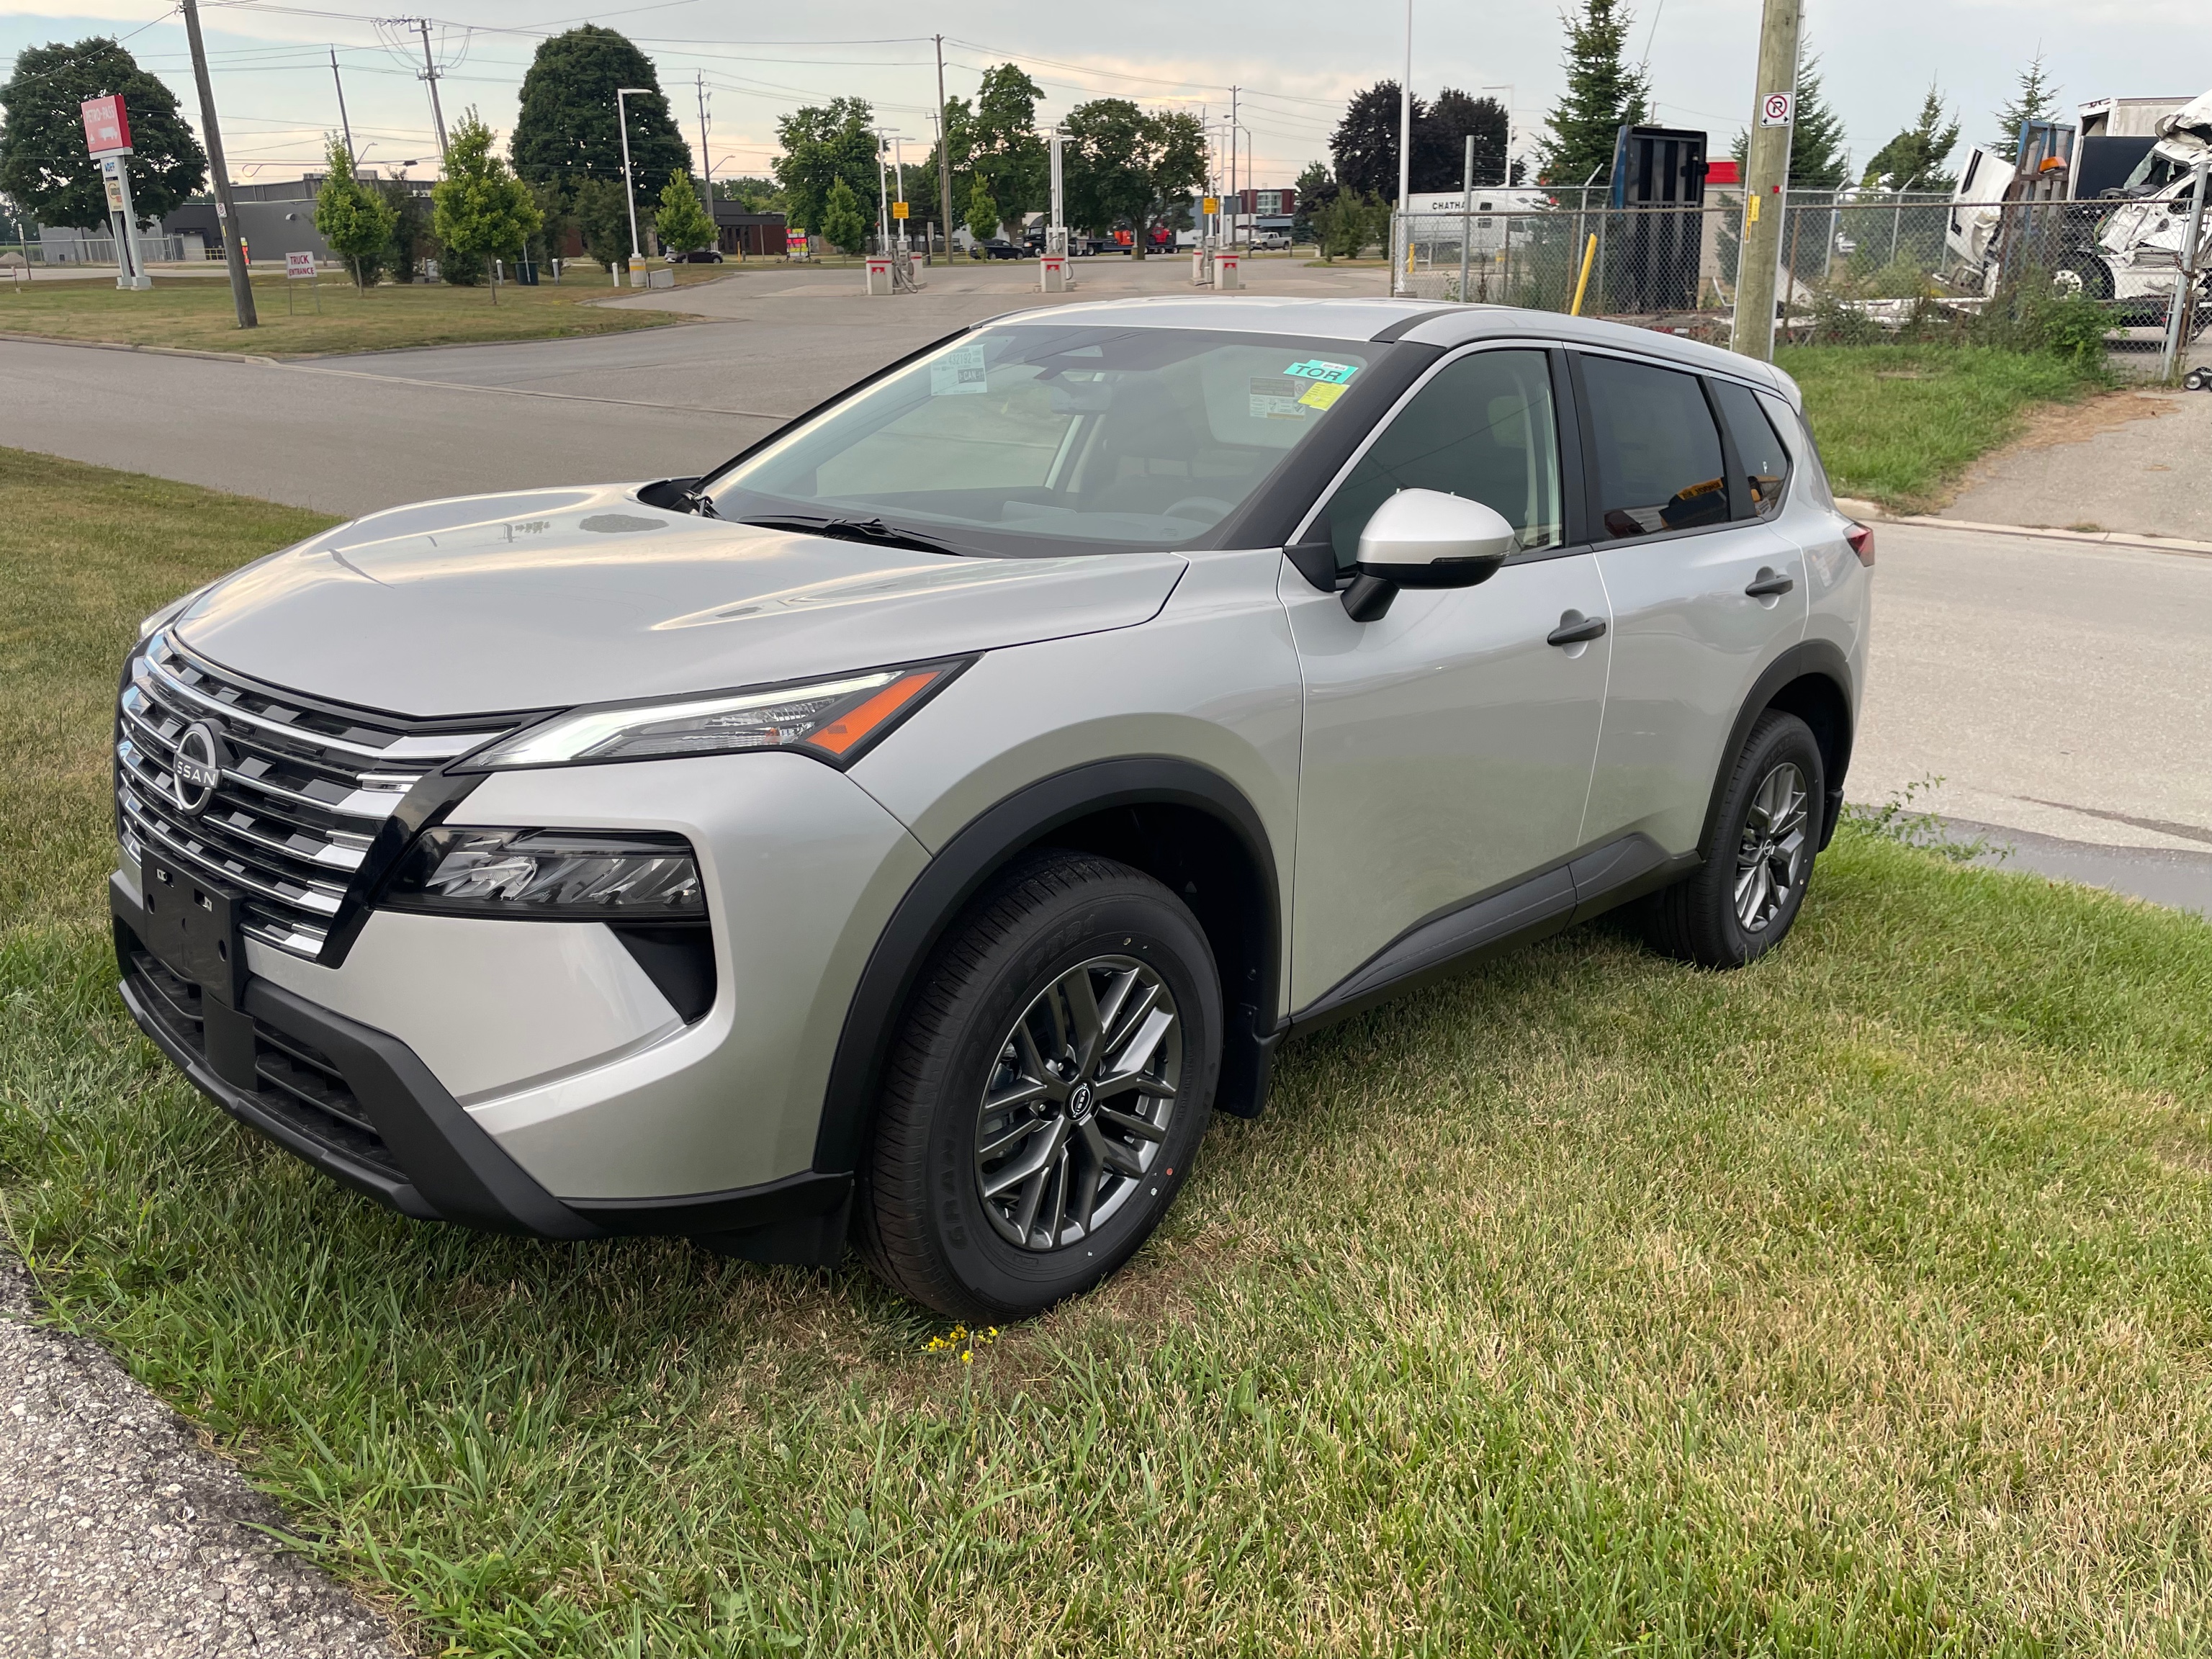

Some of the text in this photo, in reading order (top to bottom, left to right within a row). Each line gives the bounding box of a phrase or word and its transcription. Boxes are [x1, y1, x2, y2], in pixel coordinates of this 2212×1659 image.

[85, 105, 115, 124] PETRO-PASS
[289, 255, 310, 265] TRUCK
[289, 267, 315, 276] ENTRANCE
[1295, 364, 1342, 380] TOR
